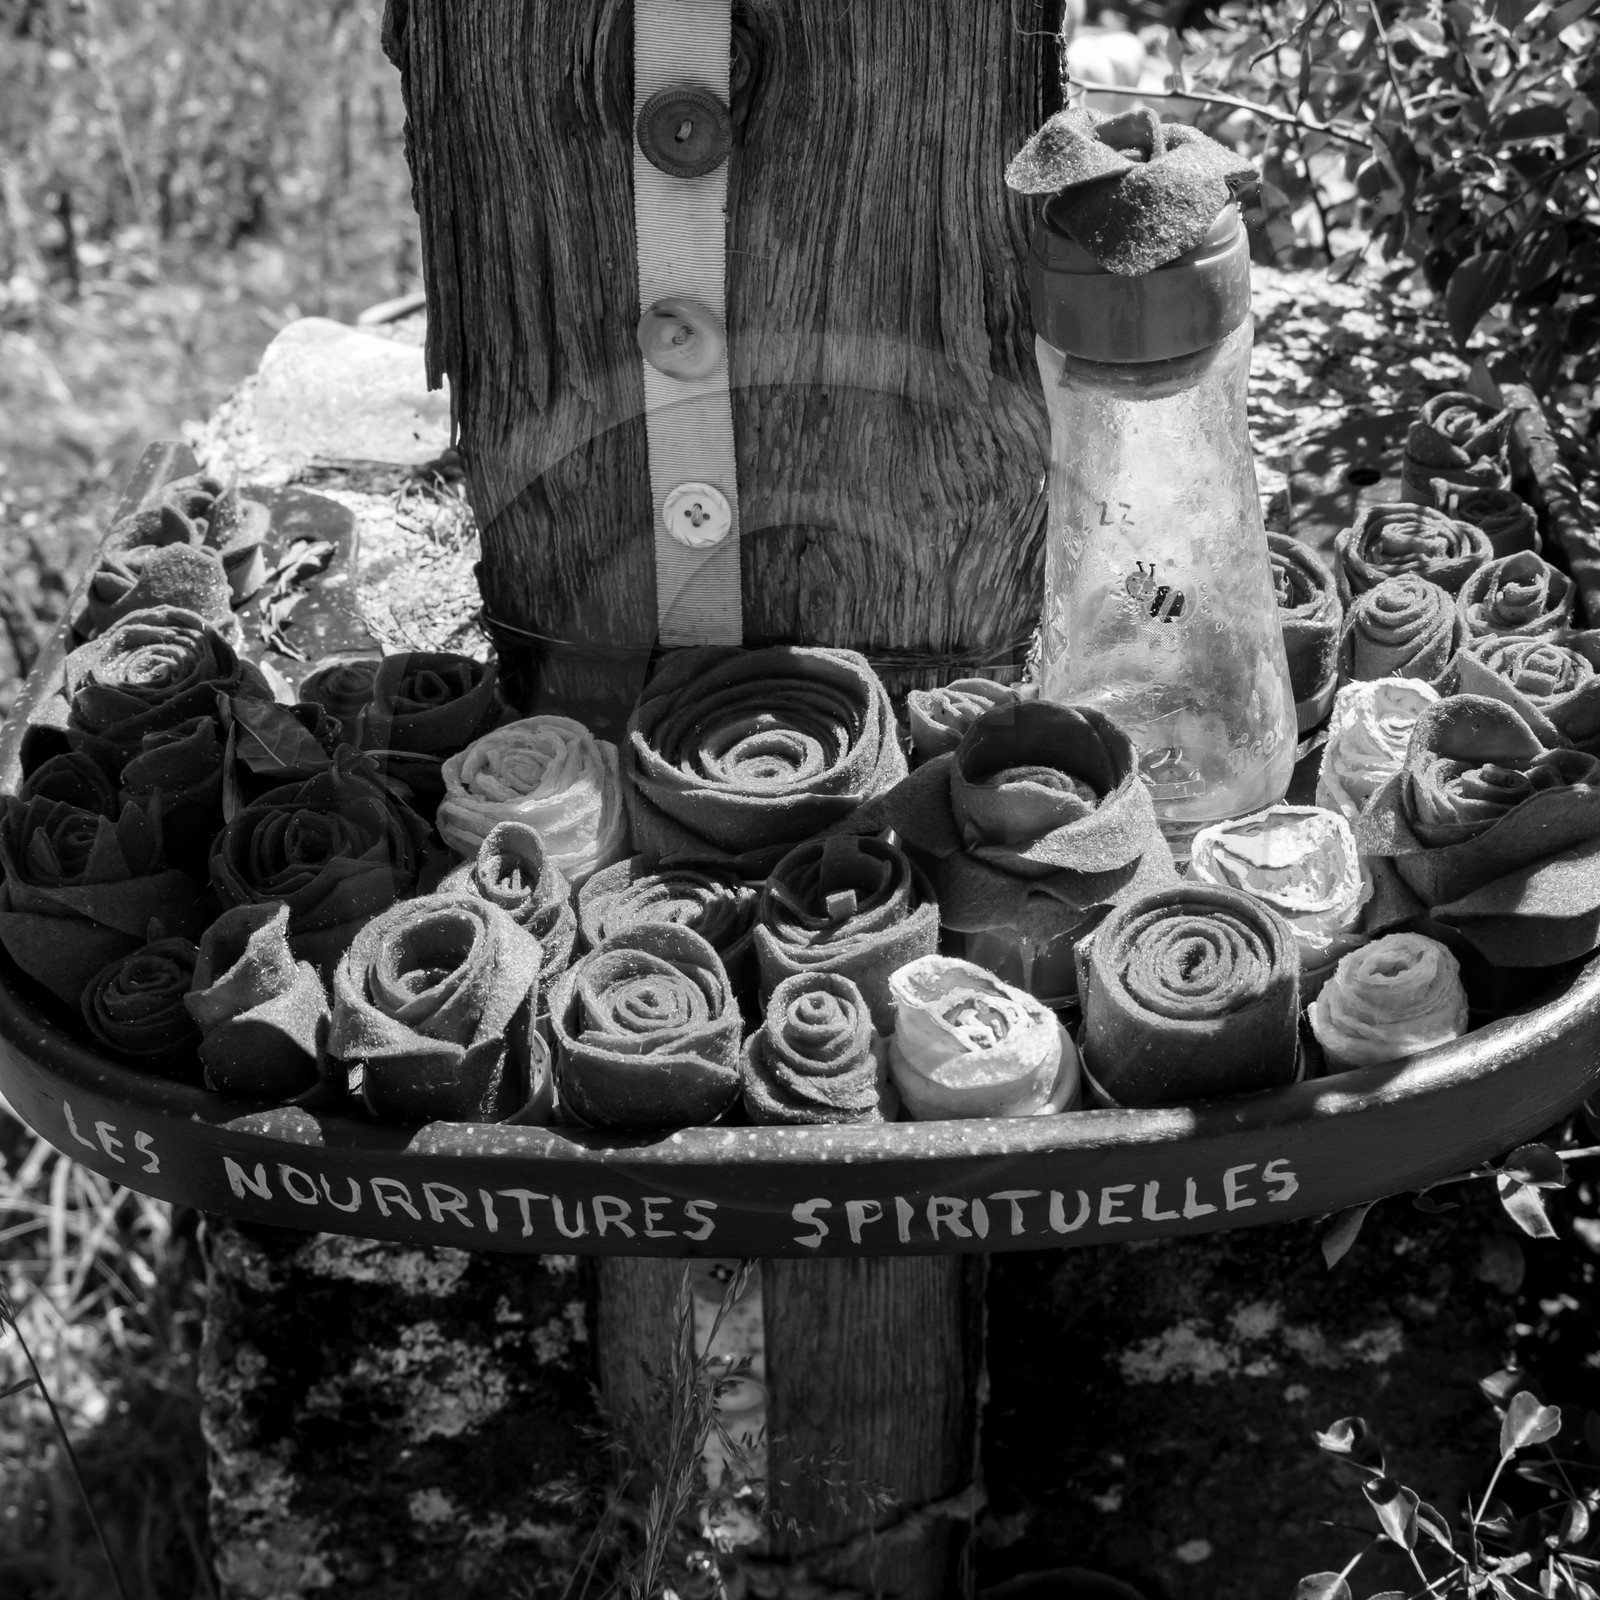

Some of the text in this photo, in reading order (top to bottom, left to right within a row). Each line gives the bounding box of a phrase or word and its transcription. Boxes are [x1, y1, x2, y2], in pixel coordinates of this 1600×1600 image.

[63, 1100, 1300, 1248] LES NOURRITURES SPIRITUELLES
